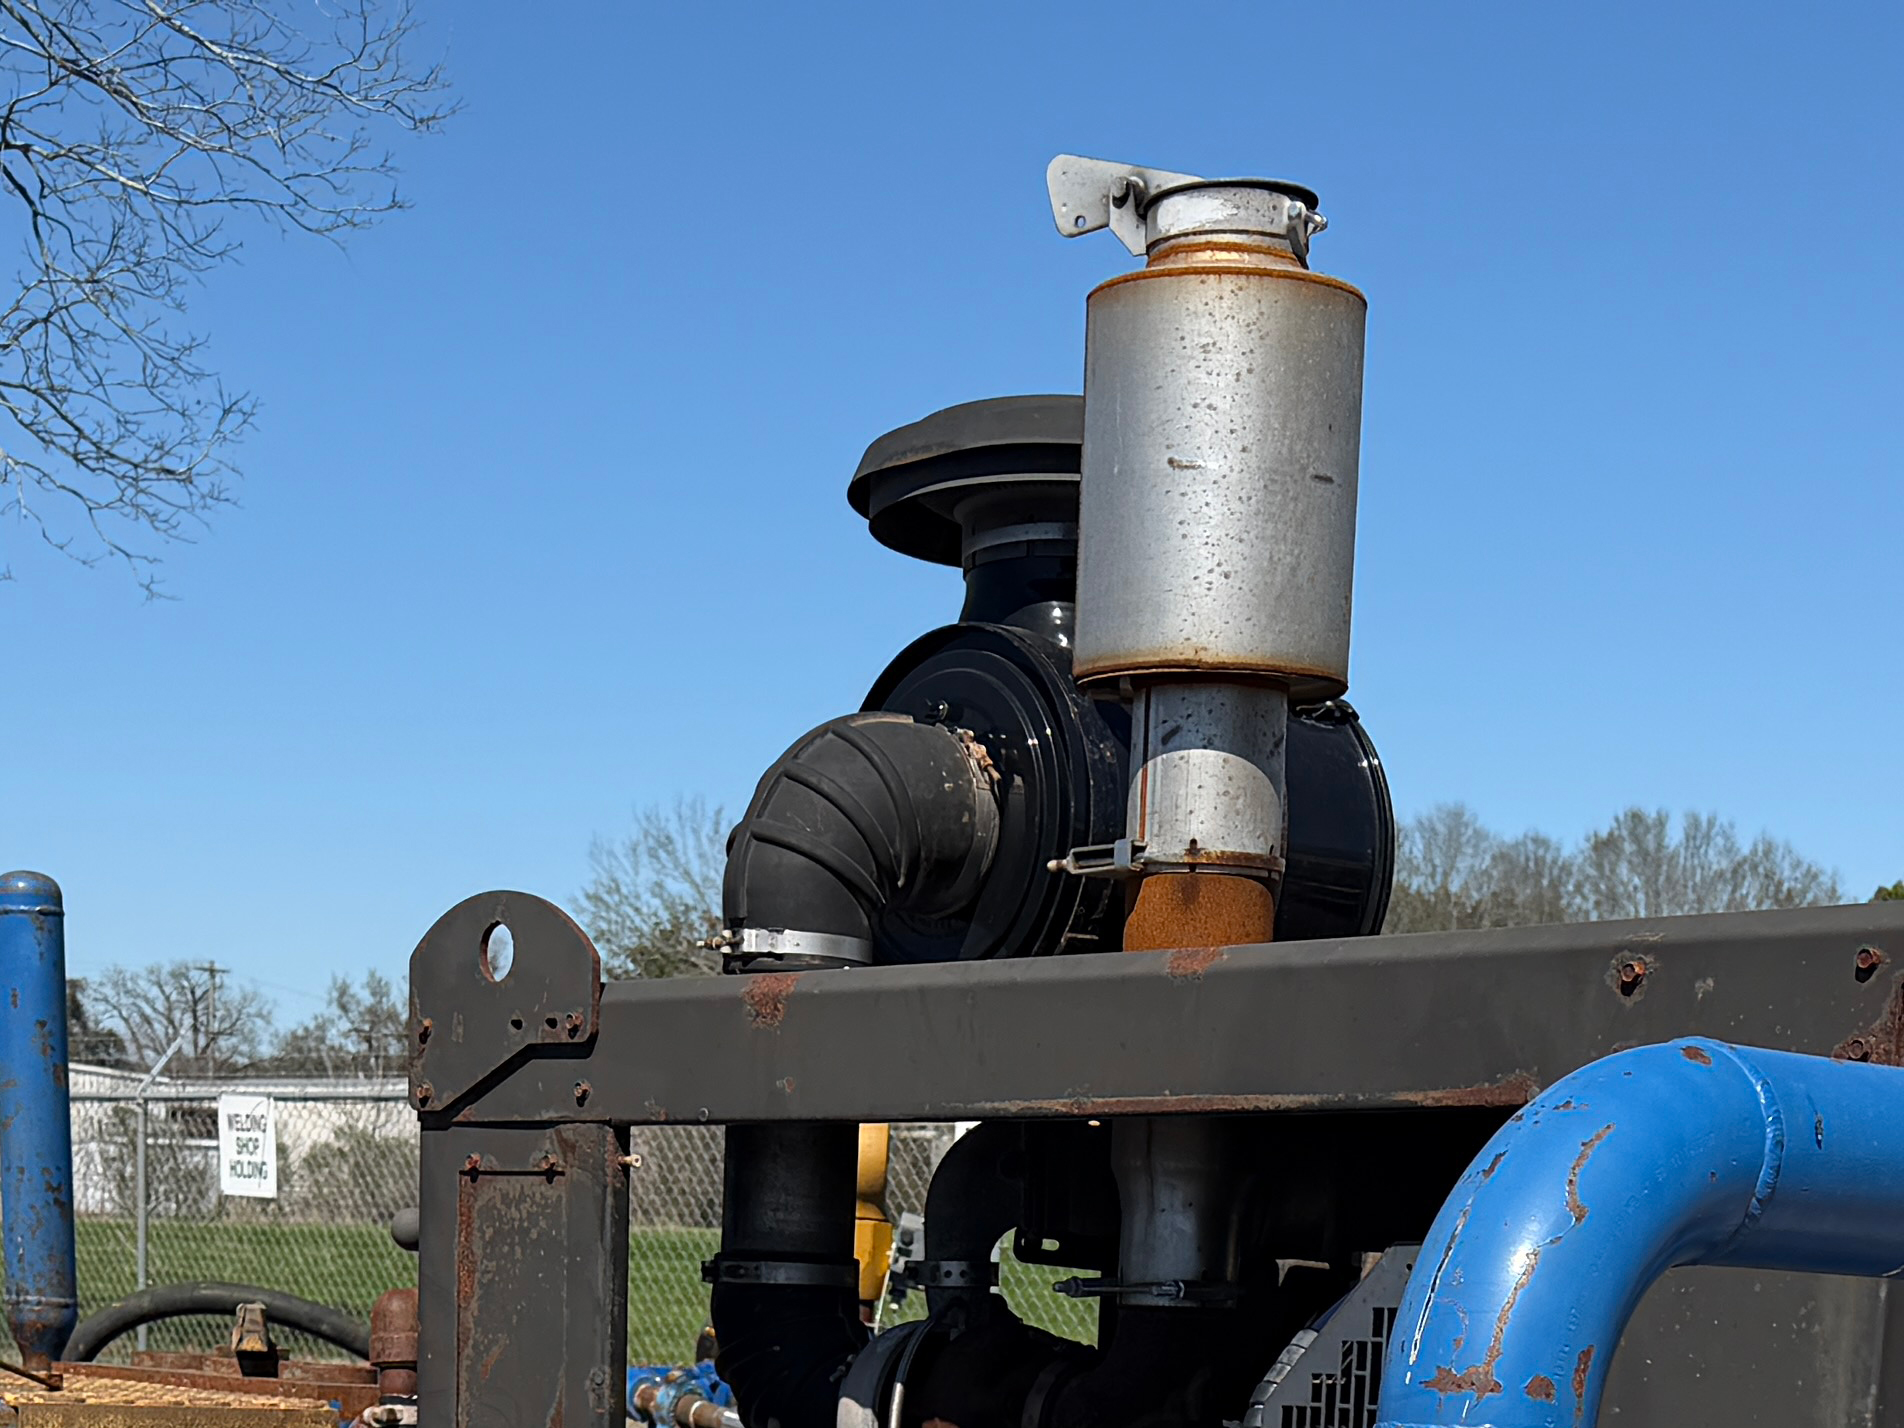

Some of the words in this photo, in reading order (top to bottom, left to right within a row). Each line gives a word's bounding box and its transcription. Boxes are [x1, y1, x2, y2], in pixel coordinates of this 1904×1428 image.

[227, 1113, 267, 1133] WELDING
[236, 1137, 260, 1155] SHOP
[229, 1159, 268, 1179] HOLDING
